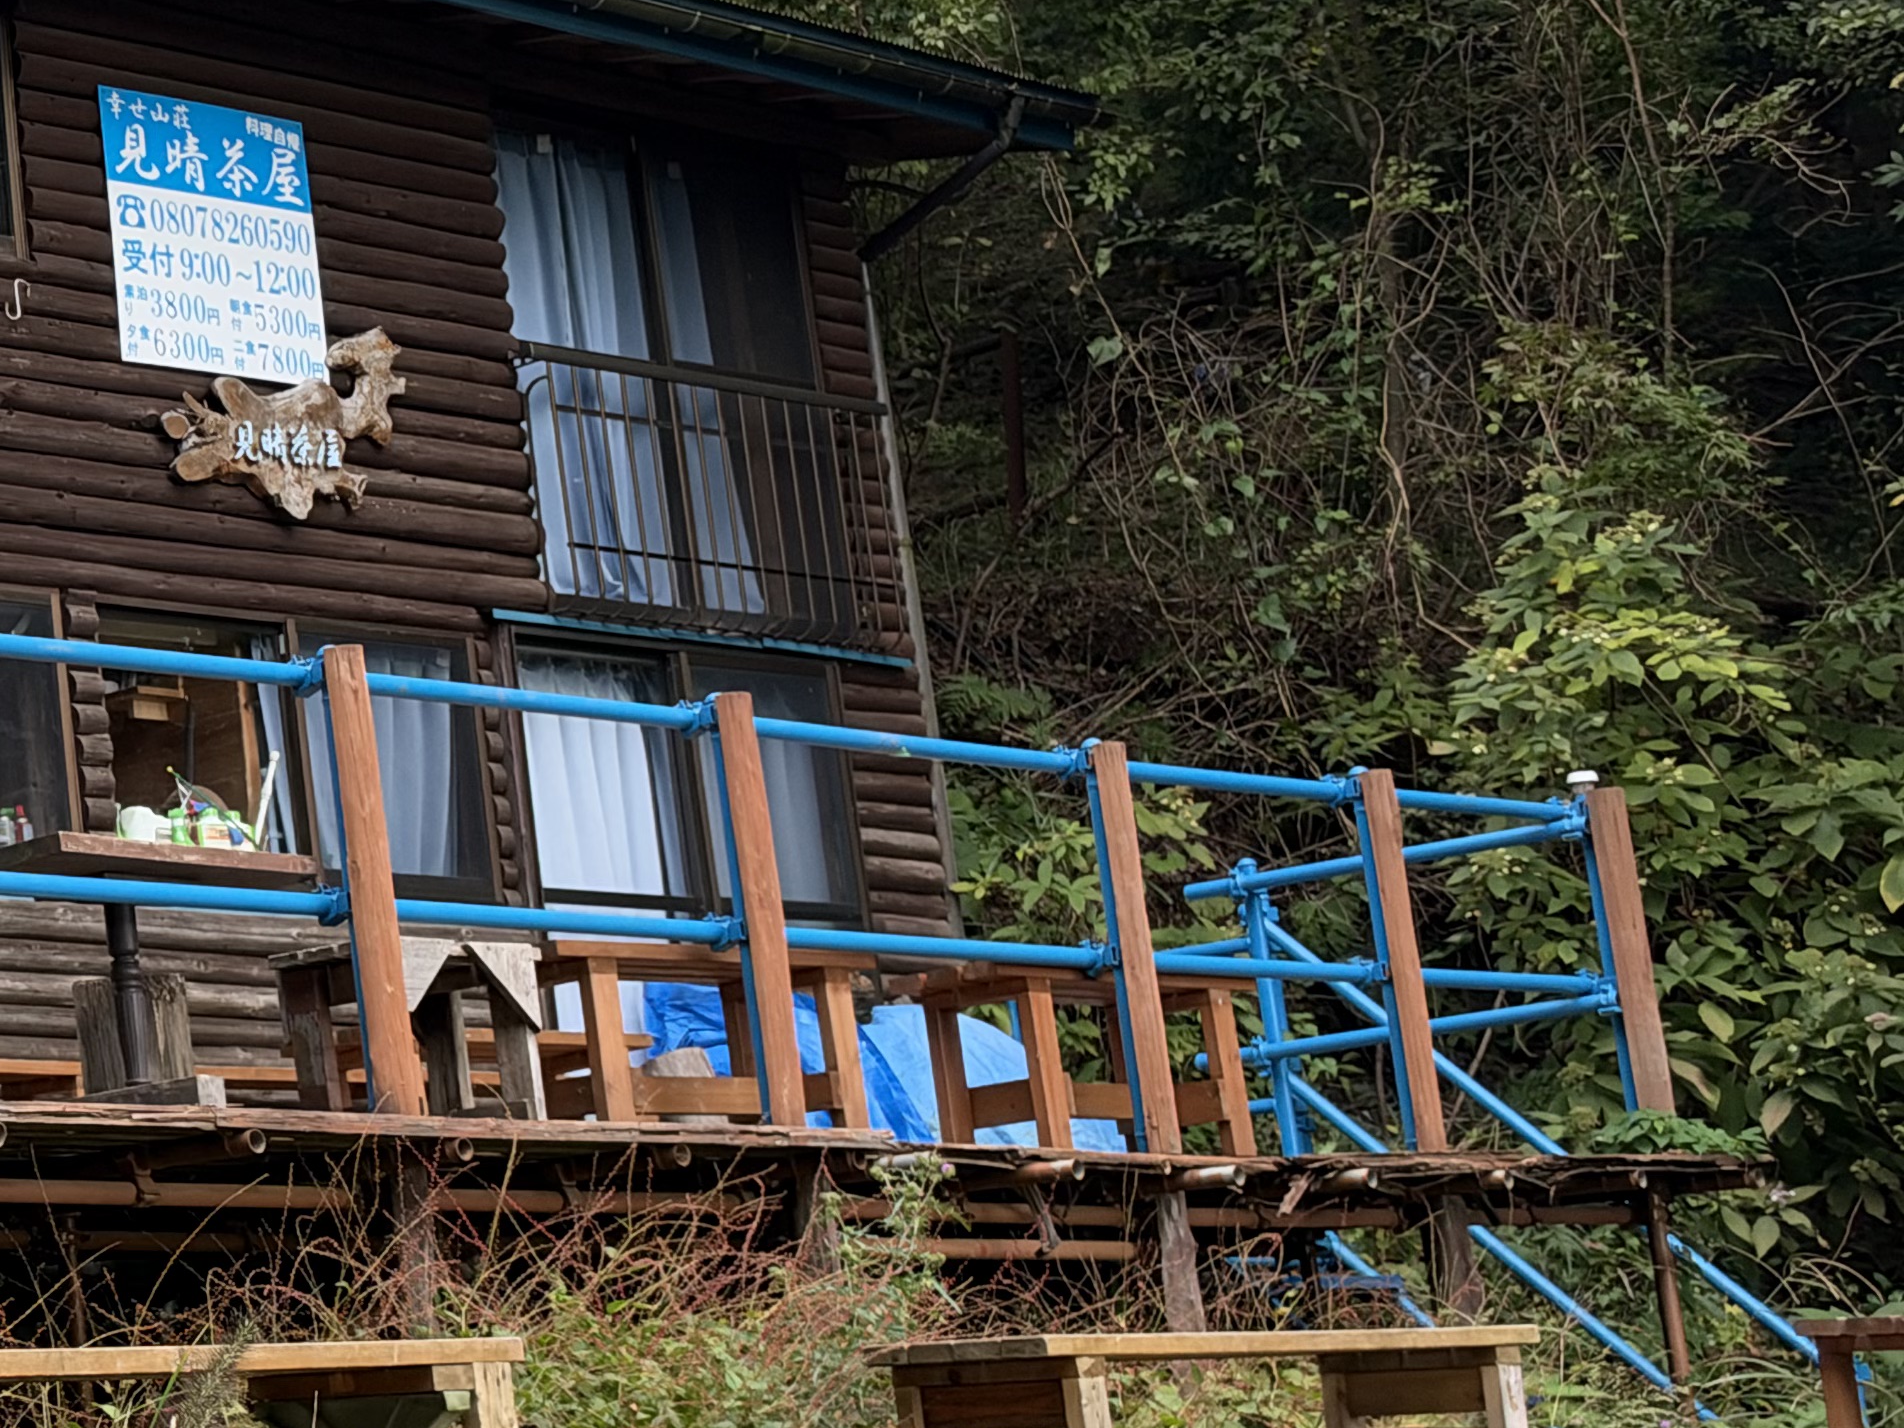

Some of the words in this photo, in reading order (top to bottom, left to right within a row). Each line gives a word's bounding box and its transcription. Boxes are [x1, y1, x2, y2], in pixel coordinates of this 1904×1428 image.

[105, 90, 192, 130] 幸せ山荘
[245, 116, 301, 151] 料理自慢
[114, 123, 305, 207] 見晴茶屋
[149, 198, 312, 257] 08078260590
[121, 238, 175, 280] 受付
[233, 420, 343, 468] 見晴茶屋
